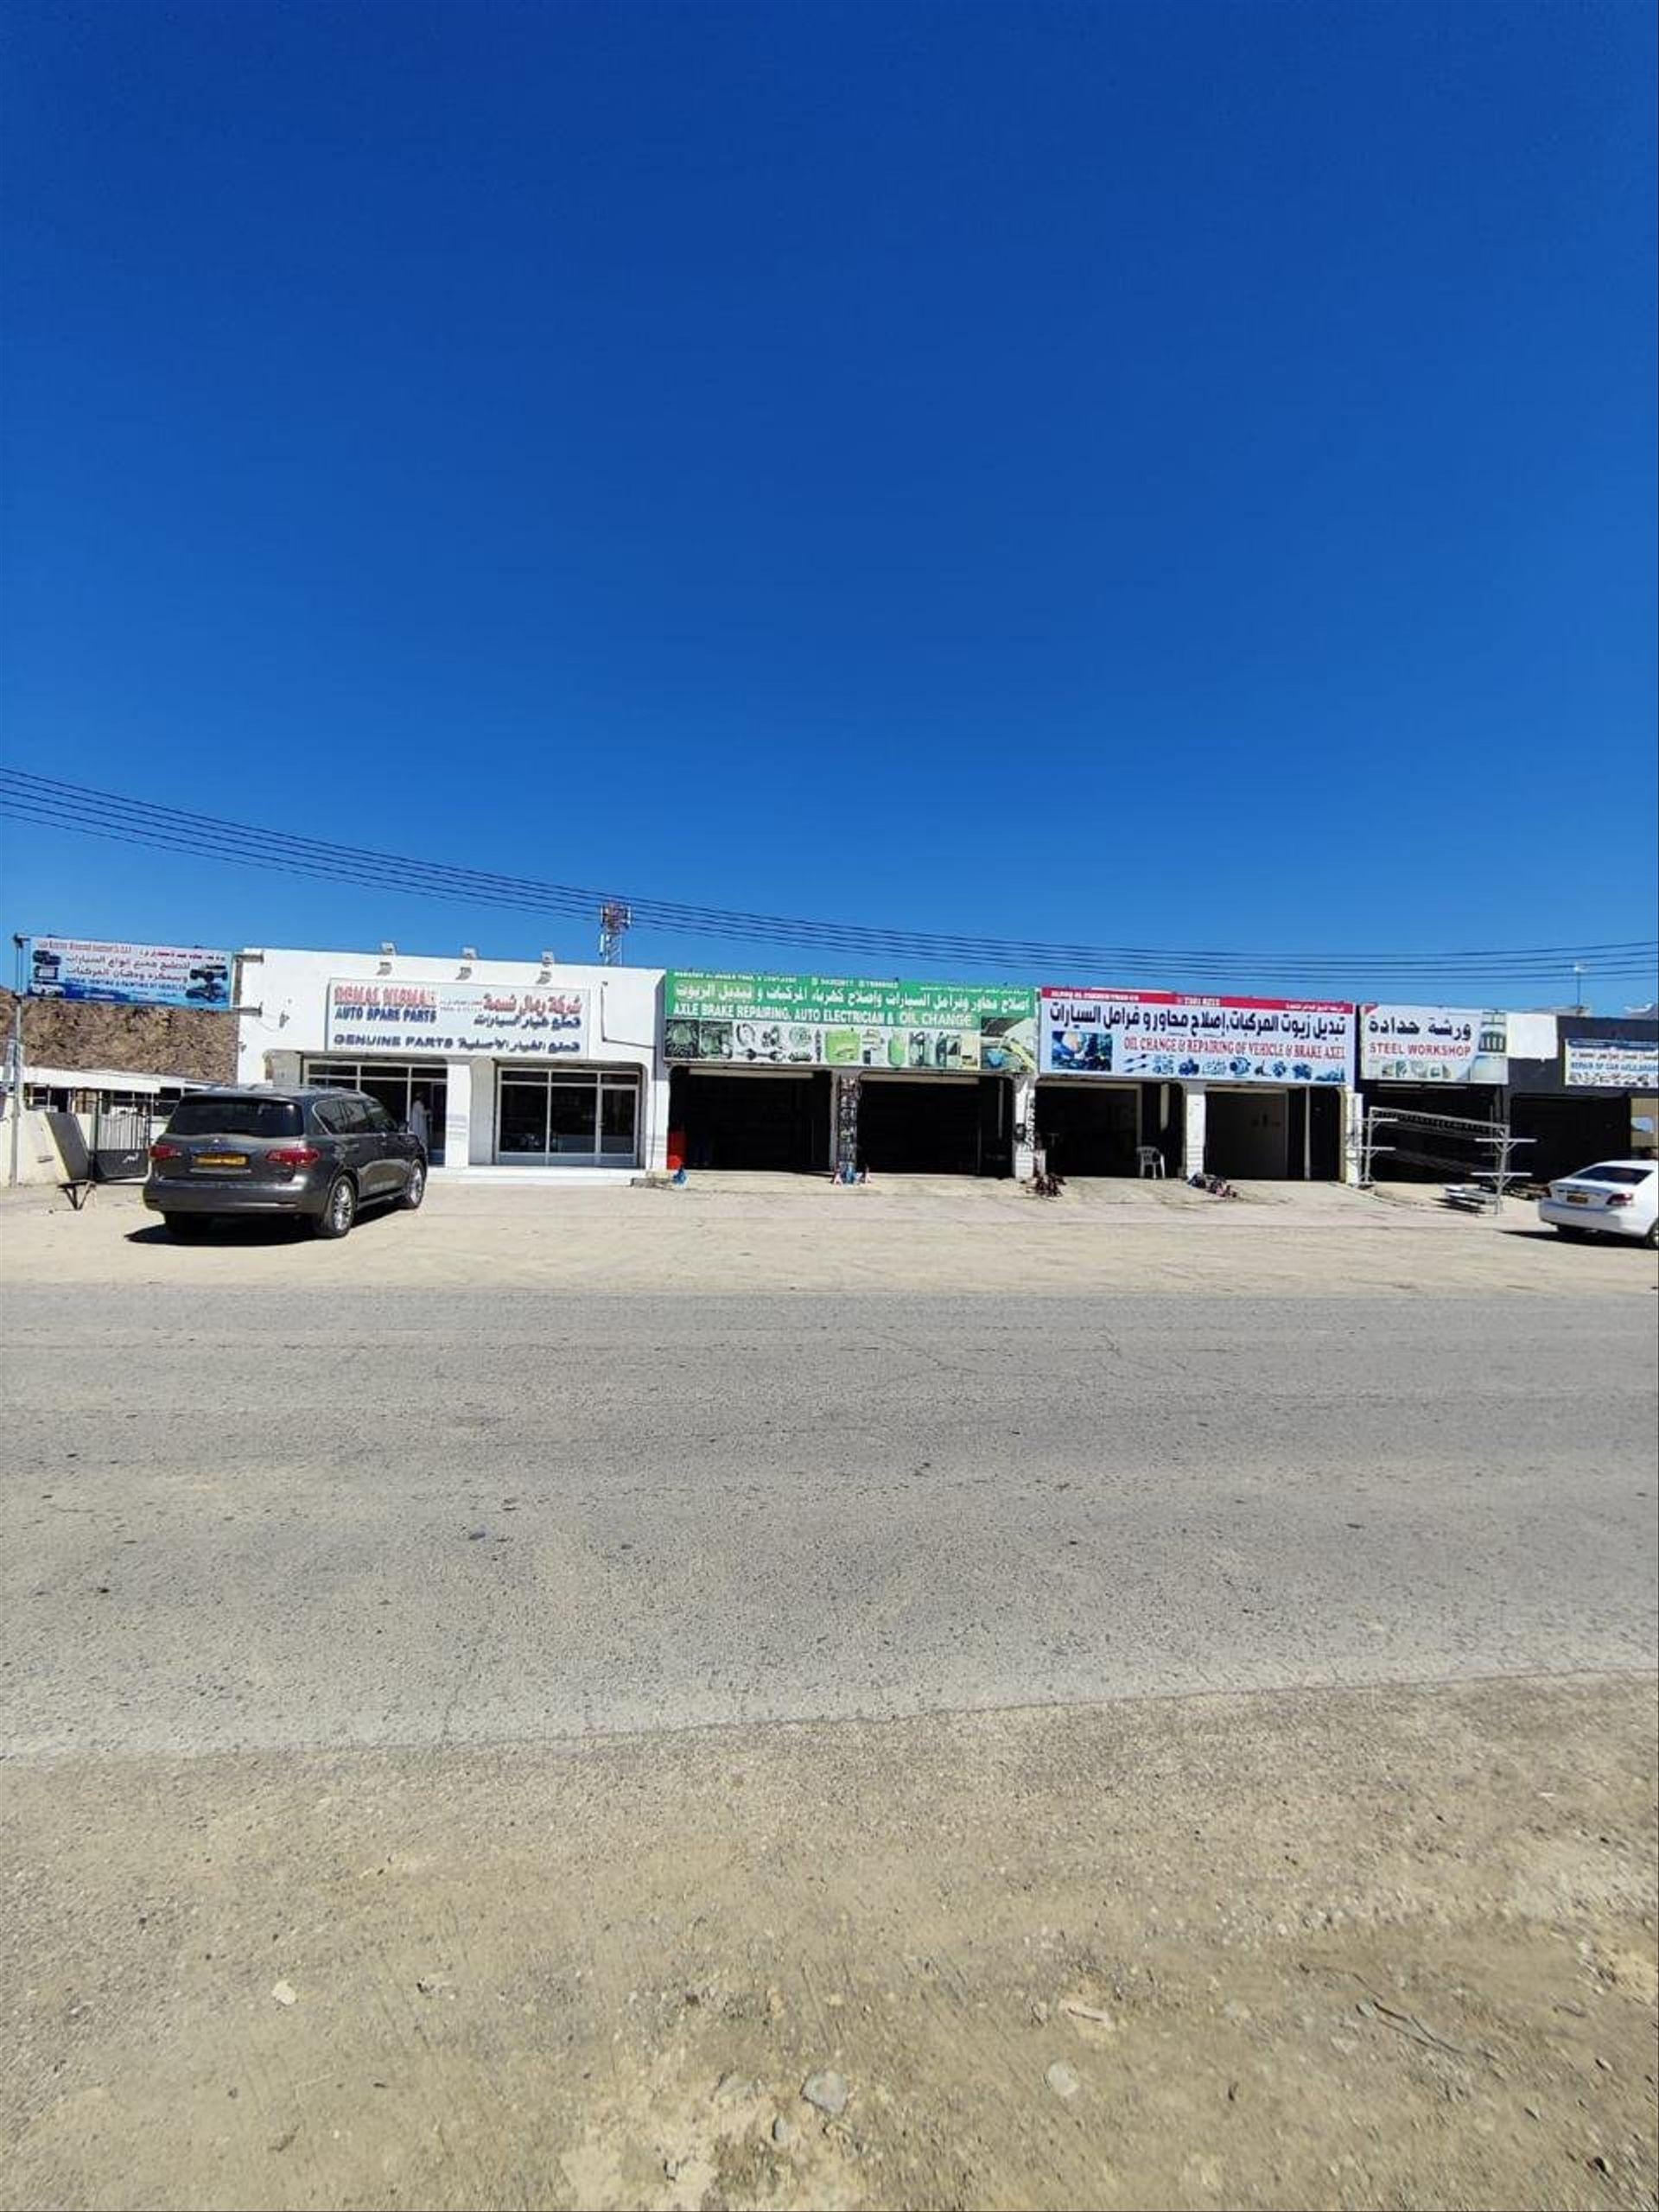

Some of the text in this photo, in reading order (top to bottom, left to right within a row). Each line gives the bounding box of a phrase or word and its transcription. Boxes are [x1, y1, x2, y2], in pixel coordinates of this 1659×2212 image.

[334, 1007, 437, 1023] AUTO SPARE PARTS
[673, 1001, 700, 1017] AXLE
[701, 1003, 734, 1019] BRAKE
[794, 1007, 822, 1021] AUTO
[823, 1008, 886, 1025] ELECTRICIAN
[899, 1011, 919, 1026] OIL
[922, 1013, 973, 1027] CHANGE
[1049, 1001, 1101, 1028] السيارات
[1103, 1005, 1141, 1030] فرامل
[1281, 1014, 1312, 1040] زيوت
[1313, 1015, 1346, 1042] تبديل
[1369, 1015, 1471, 1041] ورشة حدادة
[334, 1033, 453, 1049] GENUINE PARTS
[1140, 1037, 1178, 1052] CHANGE
[1370, 1041, 1471, 1057] STEEL WORKSHOP
